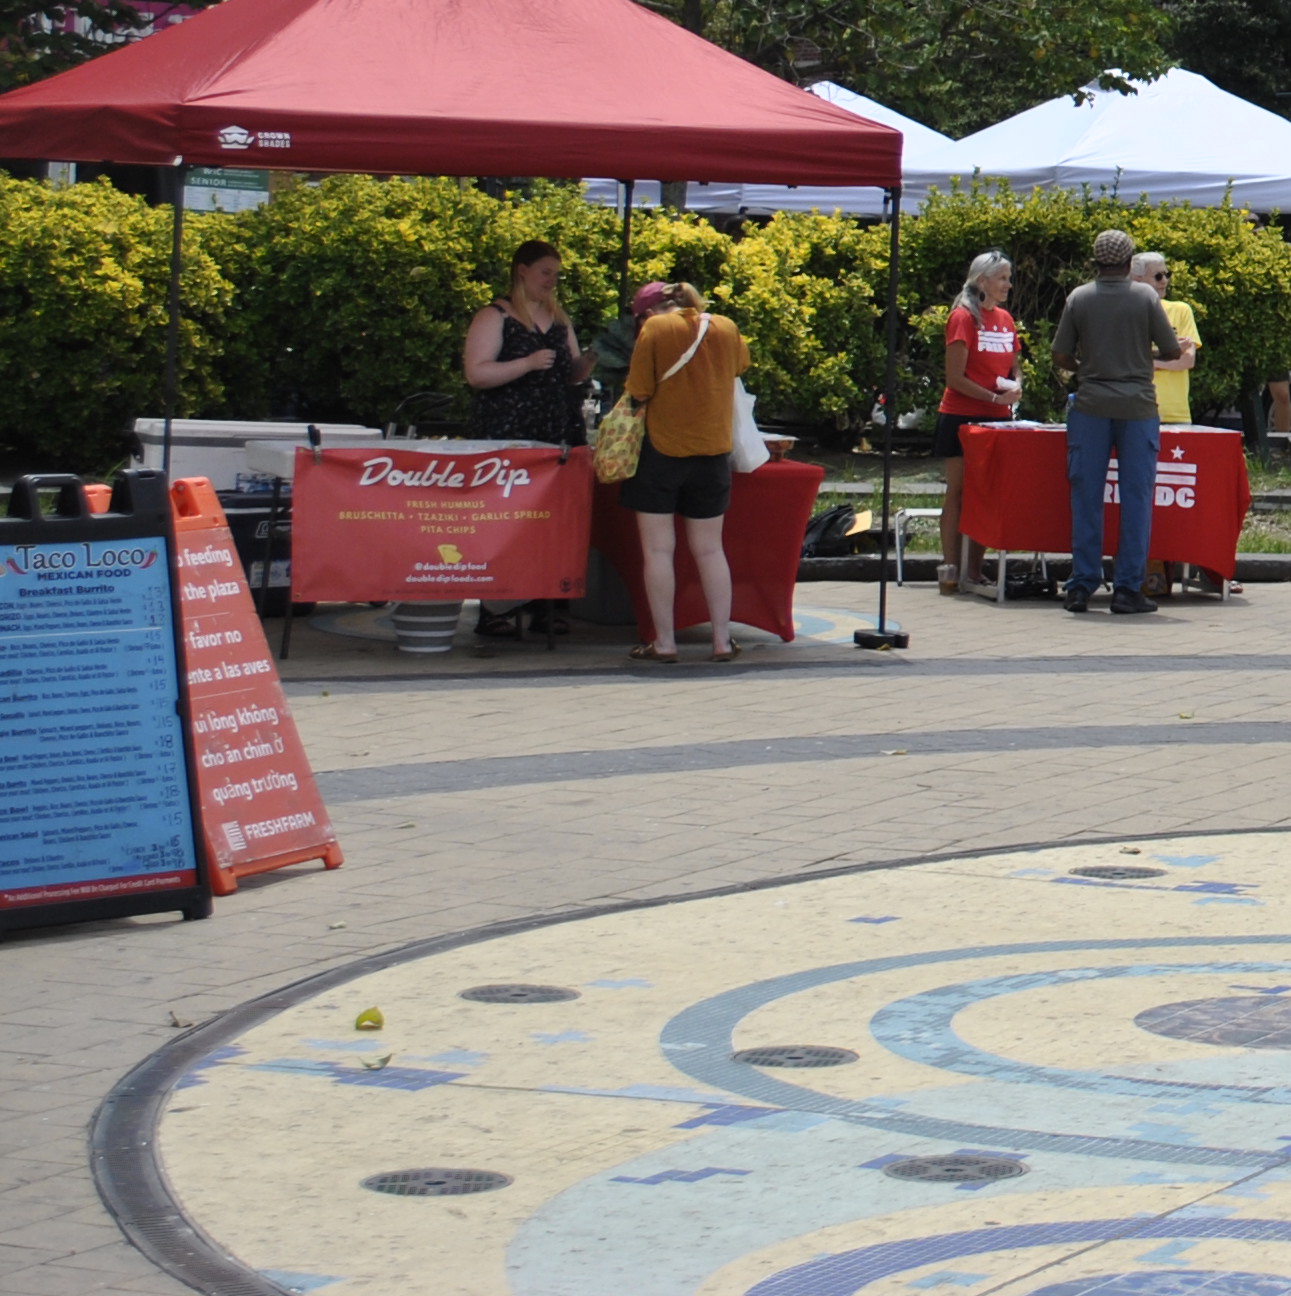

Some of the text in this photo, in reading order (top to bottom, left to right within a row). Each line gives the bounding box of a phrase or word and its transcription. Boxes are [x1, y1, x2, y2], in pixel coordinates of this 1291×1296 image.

[191, 177, 226, 186] SENIOR
[360, 456, 530, 498] Double Dip
[406, 500, 486, 508] FRESH HUMMUS
[1155, 485, 1196, 509] DC
[338, 510, 551, 522] BRUSCHETTA TZAZIKI GARLIC SPREAD
[420, 526, 476, 534] PITA CHIPS
[16, 542, 144, 570] Taco Loco
[185, 545, 233, 567] feeding
[38, 568, 132, 582] MEXICAN FOOD
[19, 584, 114, 598] Breakfast Burrito
[184, 579, 240, 602] the plaza
[190, 630, 242, 649] favor no
[214, 669, 222, 680] a
[222, 661, 242, 678] las
[242, 659, 272, 674] aves
[202, 748, 224, 768] cho
[244, 738, 274, 760] chim
[244, 811, 316, 840] FRESHFARM
